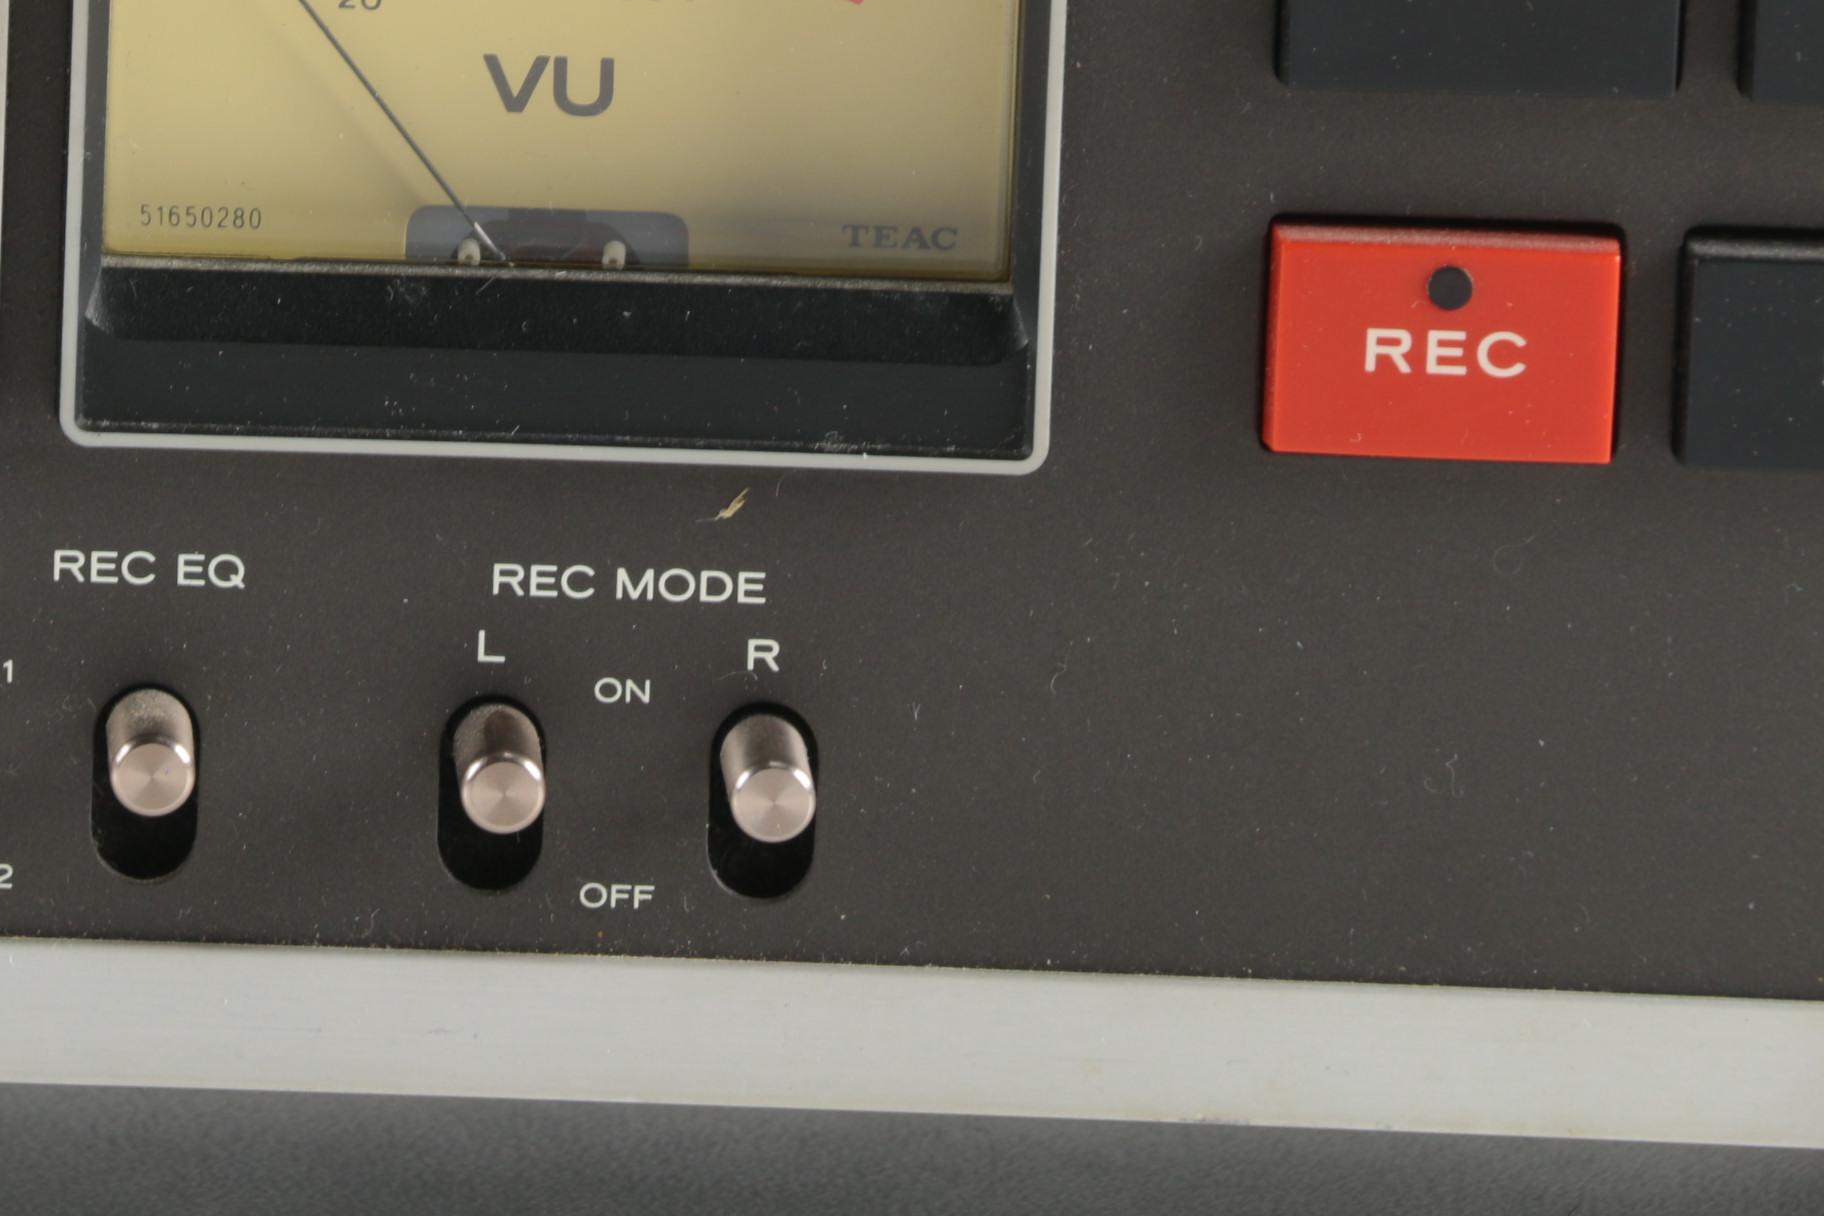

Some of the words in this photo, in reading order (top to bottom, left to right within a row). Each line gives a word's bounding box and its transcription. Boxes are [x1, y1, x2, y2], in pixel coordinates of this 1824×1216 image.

[483, 53, 615, 117] VU
[139, 202, 263, 231] 51650280
[841, 223, 959, 251] TEAC
[1363, 327, 1528, 378] REC
[53, 549, 156, 586] REC
[177, 553, 247, 589] EQ
[492, 563, 596, 600] REC
[615, 567, 767, 605] MODE
[476, 629, 506, 664] L
[746, 638, 781, 672] R
[3, 660, 14, 684] 1
[594, 677, 651, 704] ON
[579, 883, 656, 910] OFF
